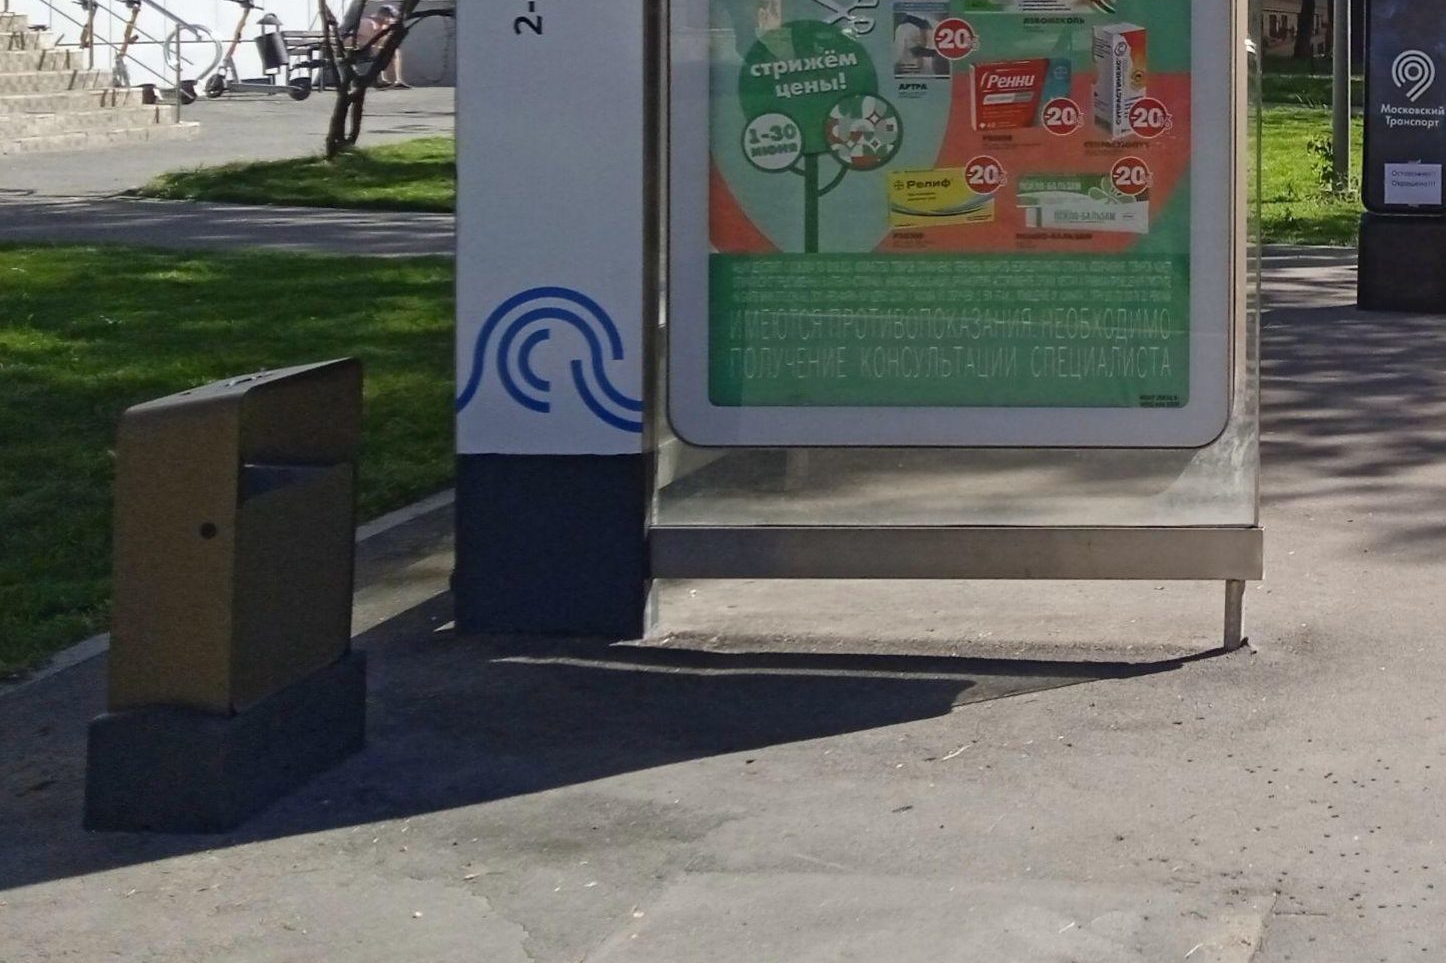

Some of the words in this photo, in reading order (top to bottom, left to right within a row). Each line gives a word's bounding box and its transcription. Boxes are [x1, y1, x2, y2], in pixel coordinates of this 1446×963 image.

[750, 50, 858, 79] стрижём
[776, 72, 847, 98] цены!
[987, 74, 1035, 89] Ренни
[1380, 103, 1446, 115] Московский
[1385, 115, 1440, 128] Транспорт
[749, 124, 797, 144] 1-30
[906, 179, 951, 190] Релиф
[1041, 307, 1171, 343] НЕОБХОДИМО
[730, 346, 848, 379] ПОЛУЧЕНИЕ
[860, 346, 1017, 379] КОНСУЛЬТАЦИИ
[1030, 346, 1172, 380] СПЕЦИАЛИСТА
